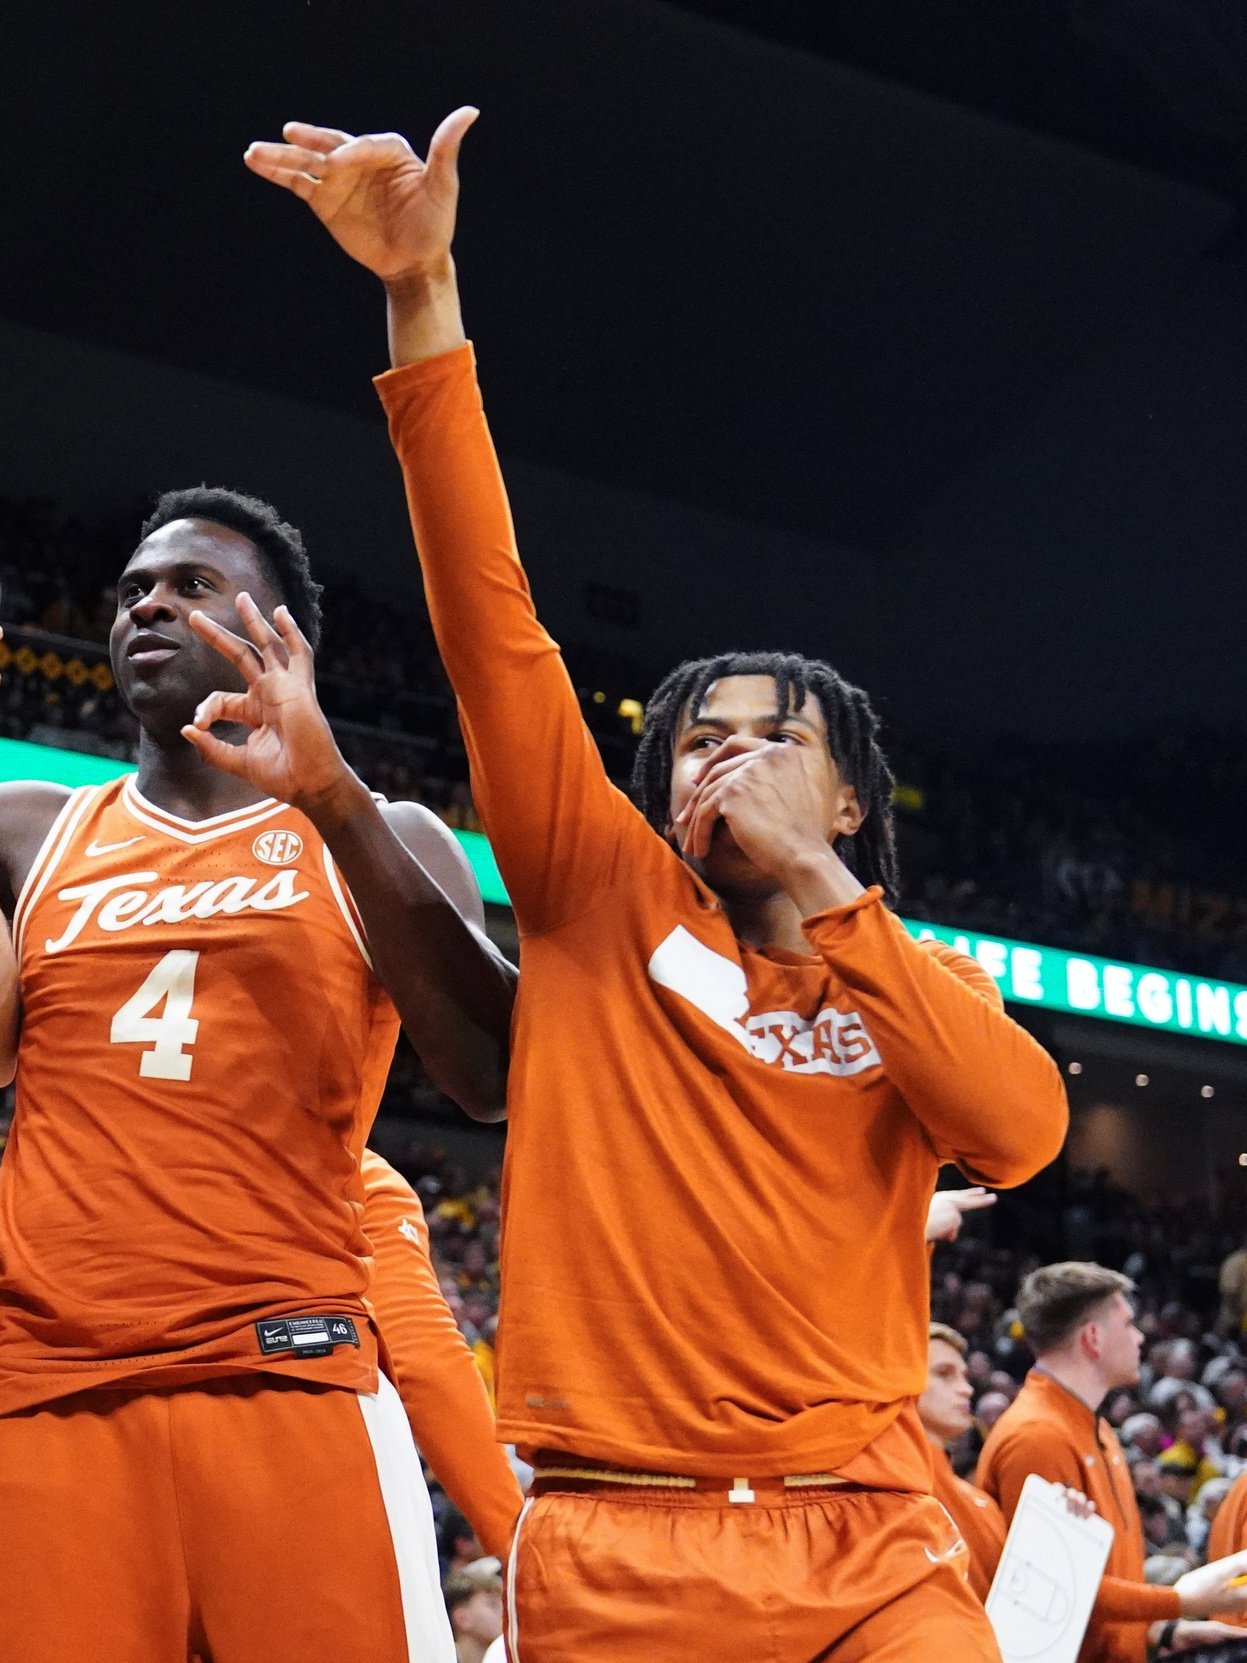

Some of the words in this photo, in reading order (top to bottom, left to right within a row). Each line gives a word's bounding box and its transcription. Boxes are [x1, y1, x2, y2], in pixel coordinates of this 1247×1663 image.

[255, 831, 302, 864] SEC
[45, 870, 310, 954] Texas
[918, 928, 1044, 1001] FE
[110, 949, 200, 1081] 4
[332, 1323, 348, 1335] 46
